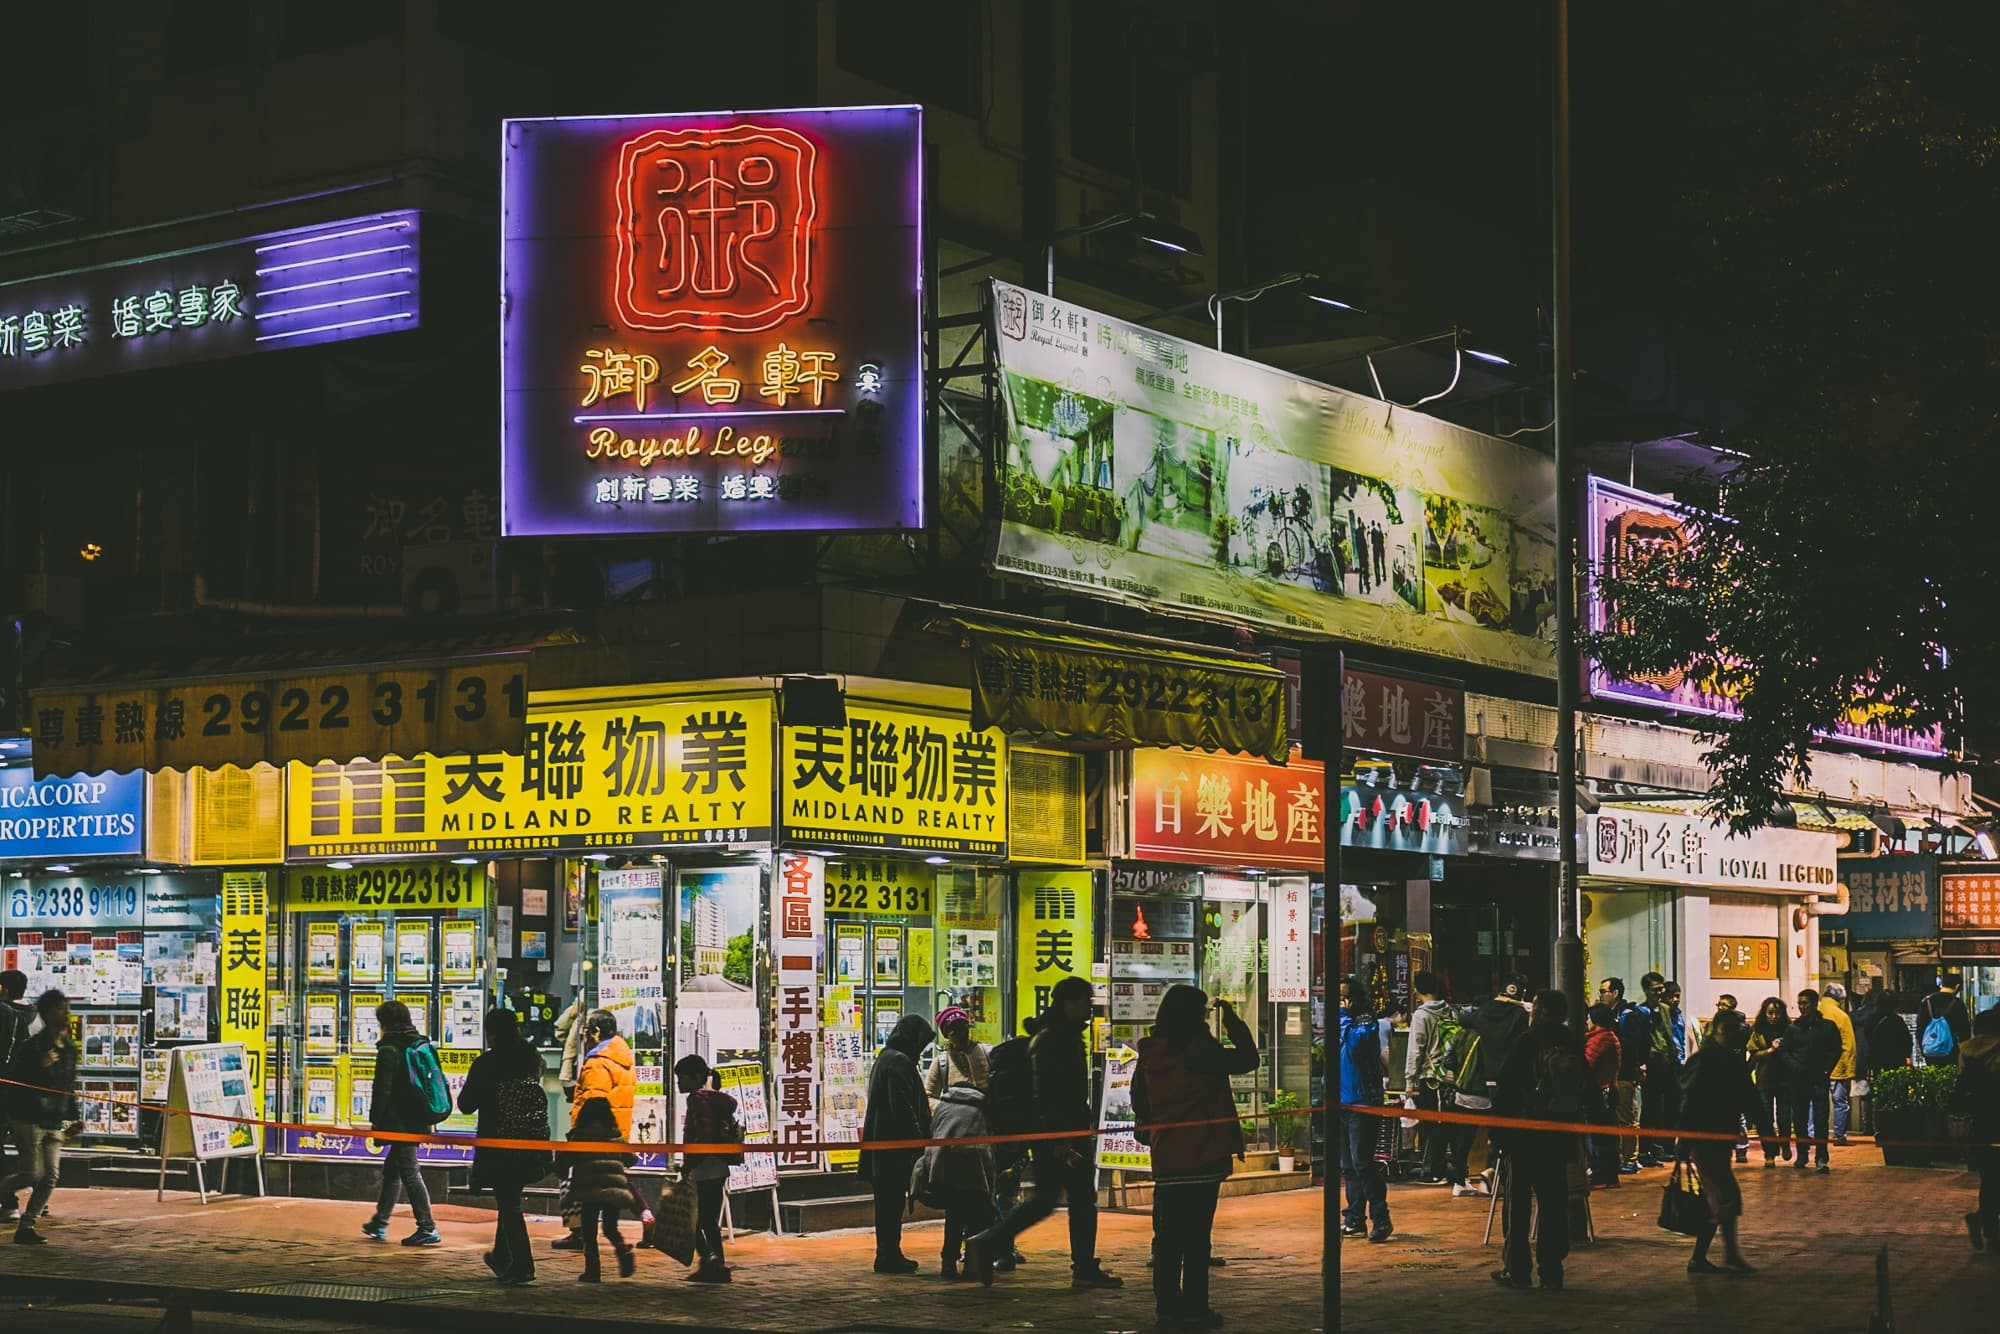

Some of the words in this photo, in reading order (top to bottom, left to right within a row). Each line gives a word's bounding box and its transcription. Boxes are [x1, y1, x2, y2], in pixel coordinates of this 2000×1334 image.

[112, 279, 242, 338] 婚宴專家
[1032, 298, 1079, 335] 御名軒
[1030, 329, 1054, 346] Royal
[581, 343, 839, 412] 御名軒
[586, 426, 700, 468] Royal
[1095, 666, 1191, 712] 2922
[36, 700, 186, 749] 尊貴熱線
[202, 684, 351, 738] 2922
[372, 673, 524, 726] 3131
[442, 711, 747, 805] 美聯物業
[792, 718, 997, 807] 美聯物業
[1, 782, 107, 808] ICACORP
[792, 798, 904, 825] MIDLAND
[917, 809, 996, 832] REALTY
[1149, 772, 1321, 845] 百樂地產
[0, 813, 136, 840] ROPERTIES
[441, 807, 592, 832] MIDLAND
[617, 801, 747, 825] REALTY
[1621, 819, 1708, 874] 御名軒
[301, 873, 358, 904] 尊貴熱線
[358, 867, 473, 905] 29223131
[1780, 863, 1834, 885] LEGEND
[1842, 870, 1929, 913] 器材料
[89, 886, 137, 917] 9119
[877, 885, 930, 912] 3131
[781, 856, 813, 1164] 各區一手樓專店
